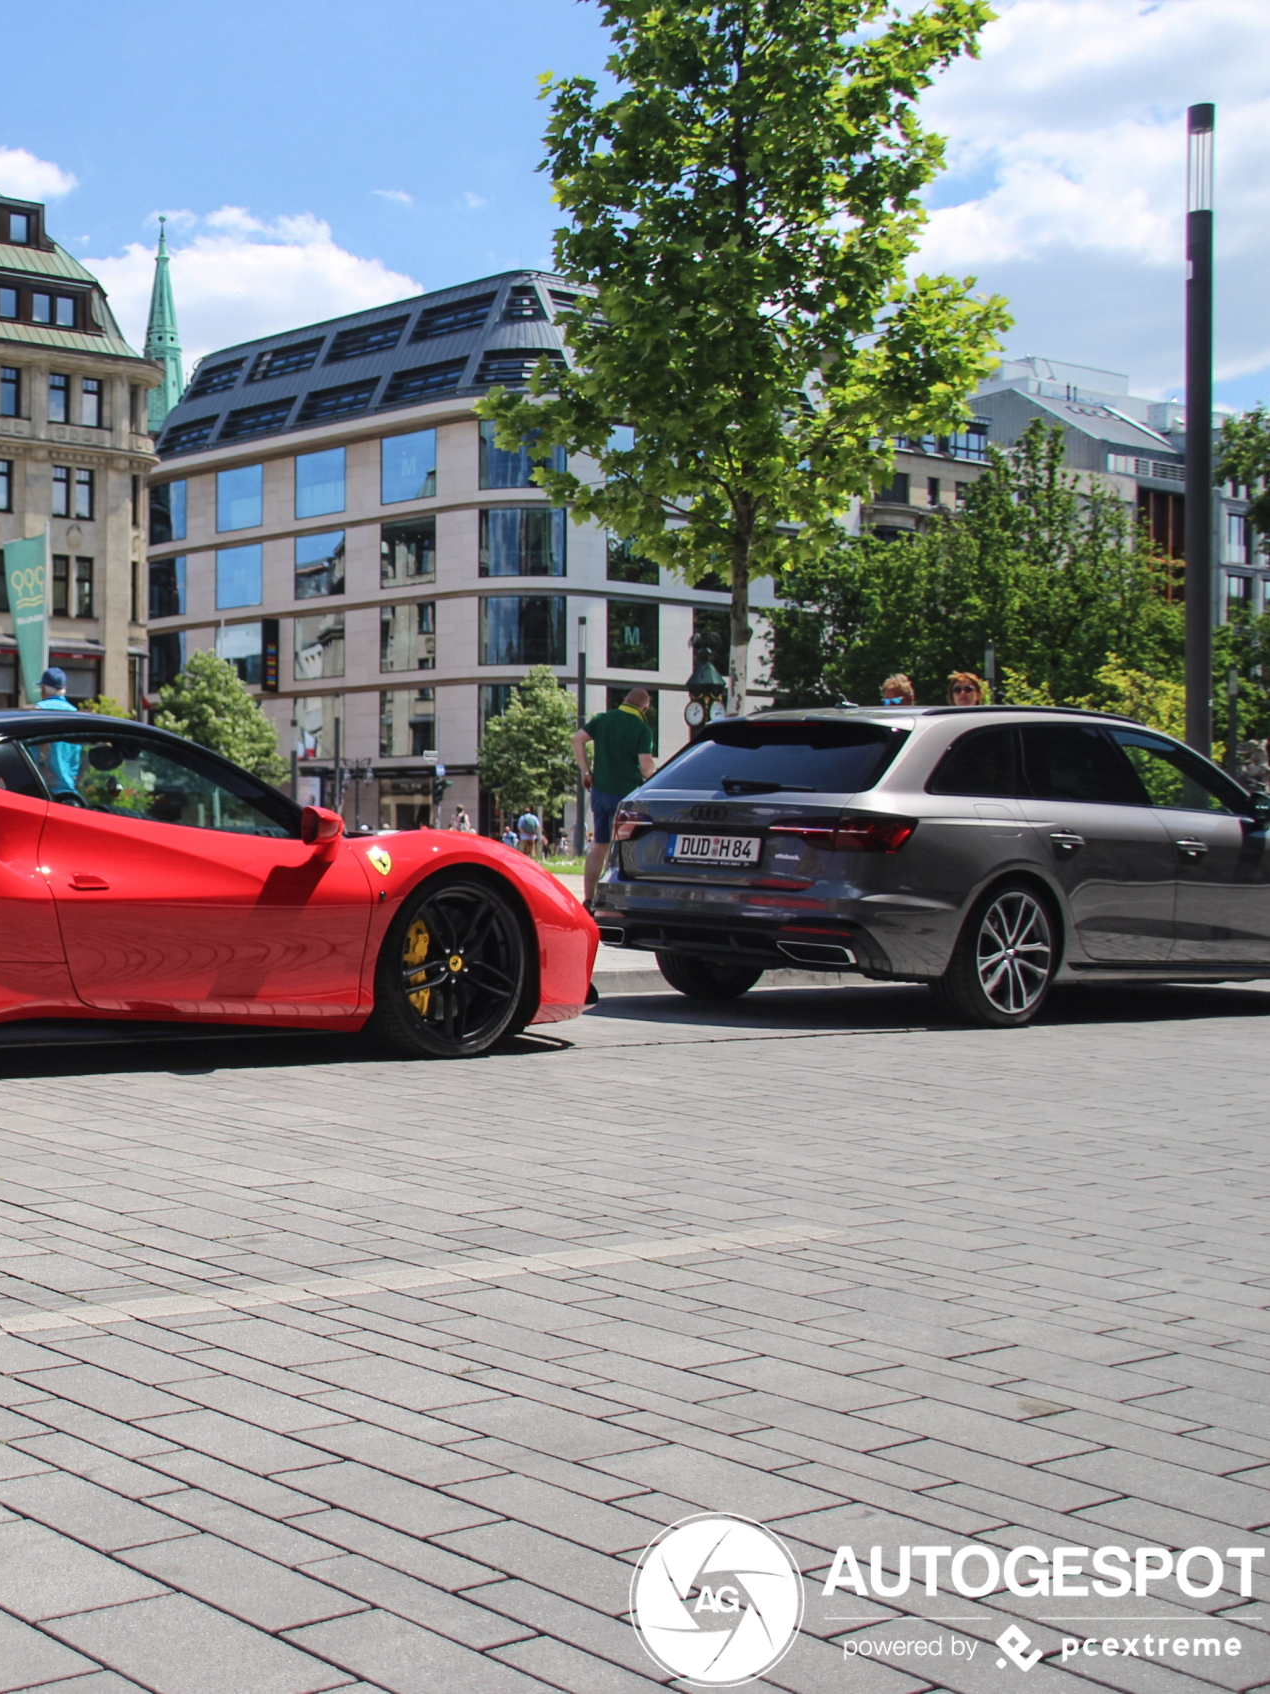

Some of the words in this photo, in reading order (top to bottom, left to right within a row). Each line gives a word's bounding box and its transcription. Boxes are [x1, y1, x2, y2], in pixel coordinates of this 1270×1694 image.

[679, 837, 711, 856] DUD
[718, 838, 731, 857] H
[732, 840, 752, 859] 84
